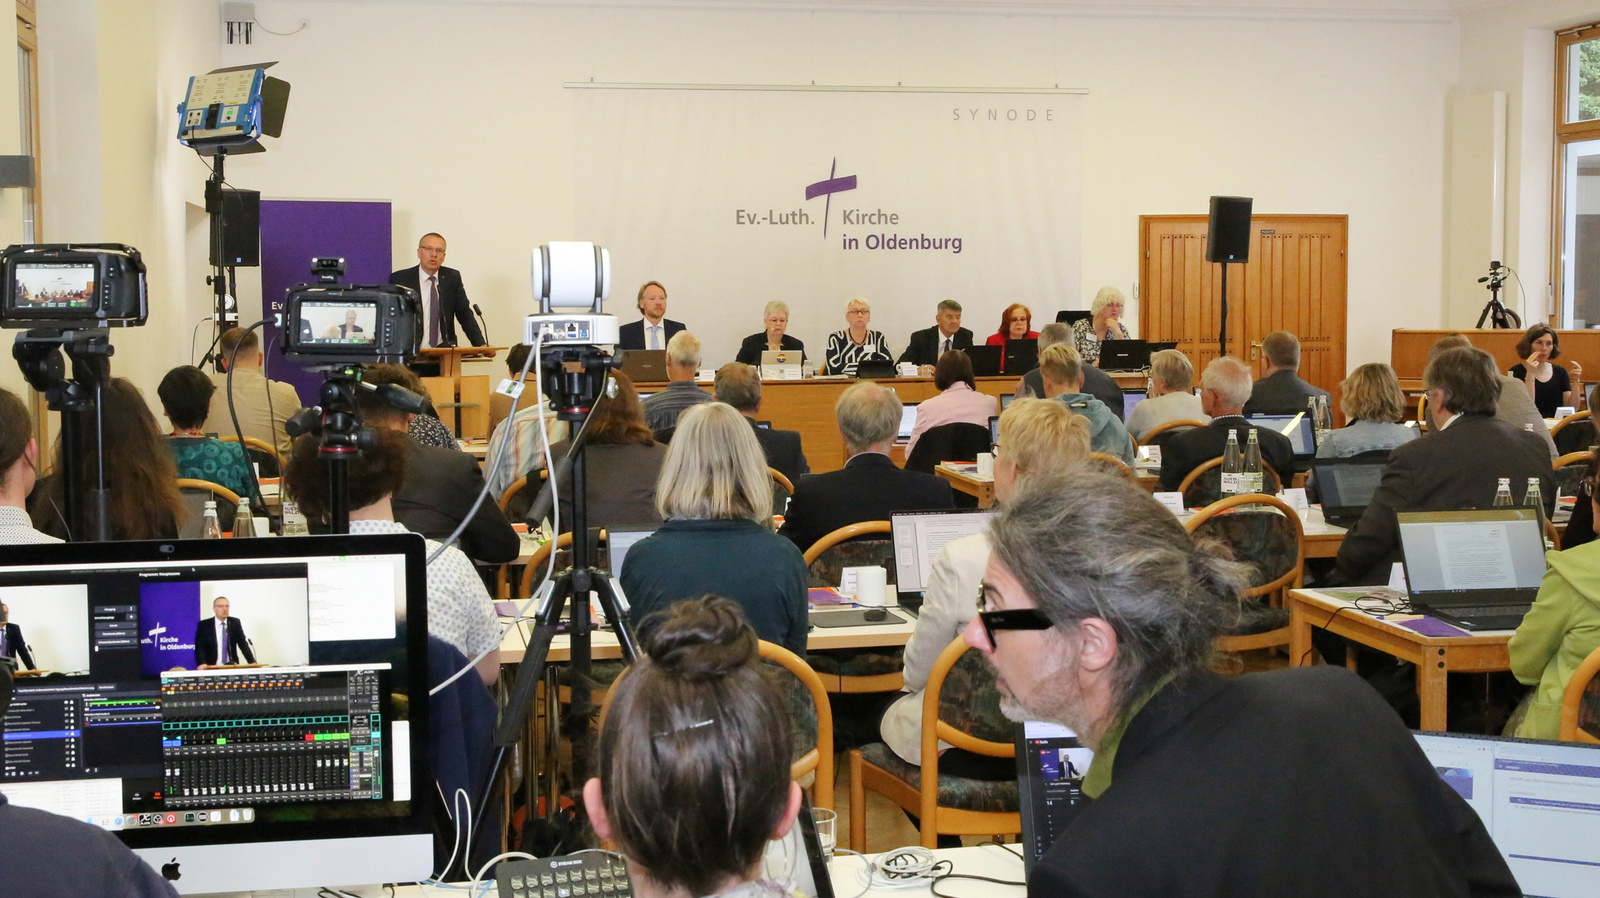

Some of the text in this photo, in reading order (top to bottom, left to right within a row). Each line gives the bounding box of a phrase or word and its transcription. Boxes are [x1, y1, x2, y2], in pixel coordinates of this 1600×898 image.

[952, 108, 1054, 121] SYNODE
[736, 209, 899, 225] Ev.-Luth. Kirche
[843, 234, 962, 253] in Oldenburg
[160, 636, 179, 644] Kirche
